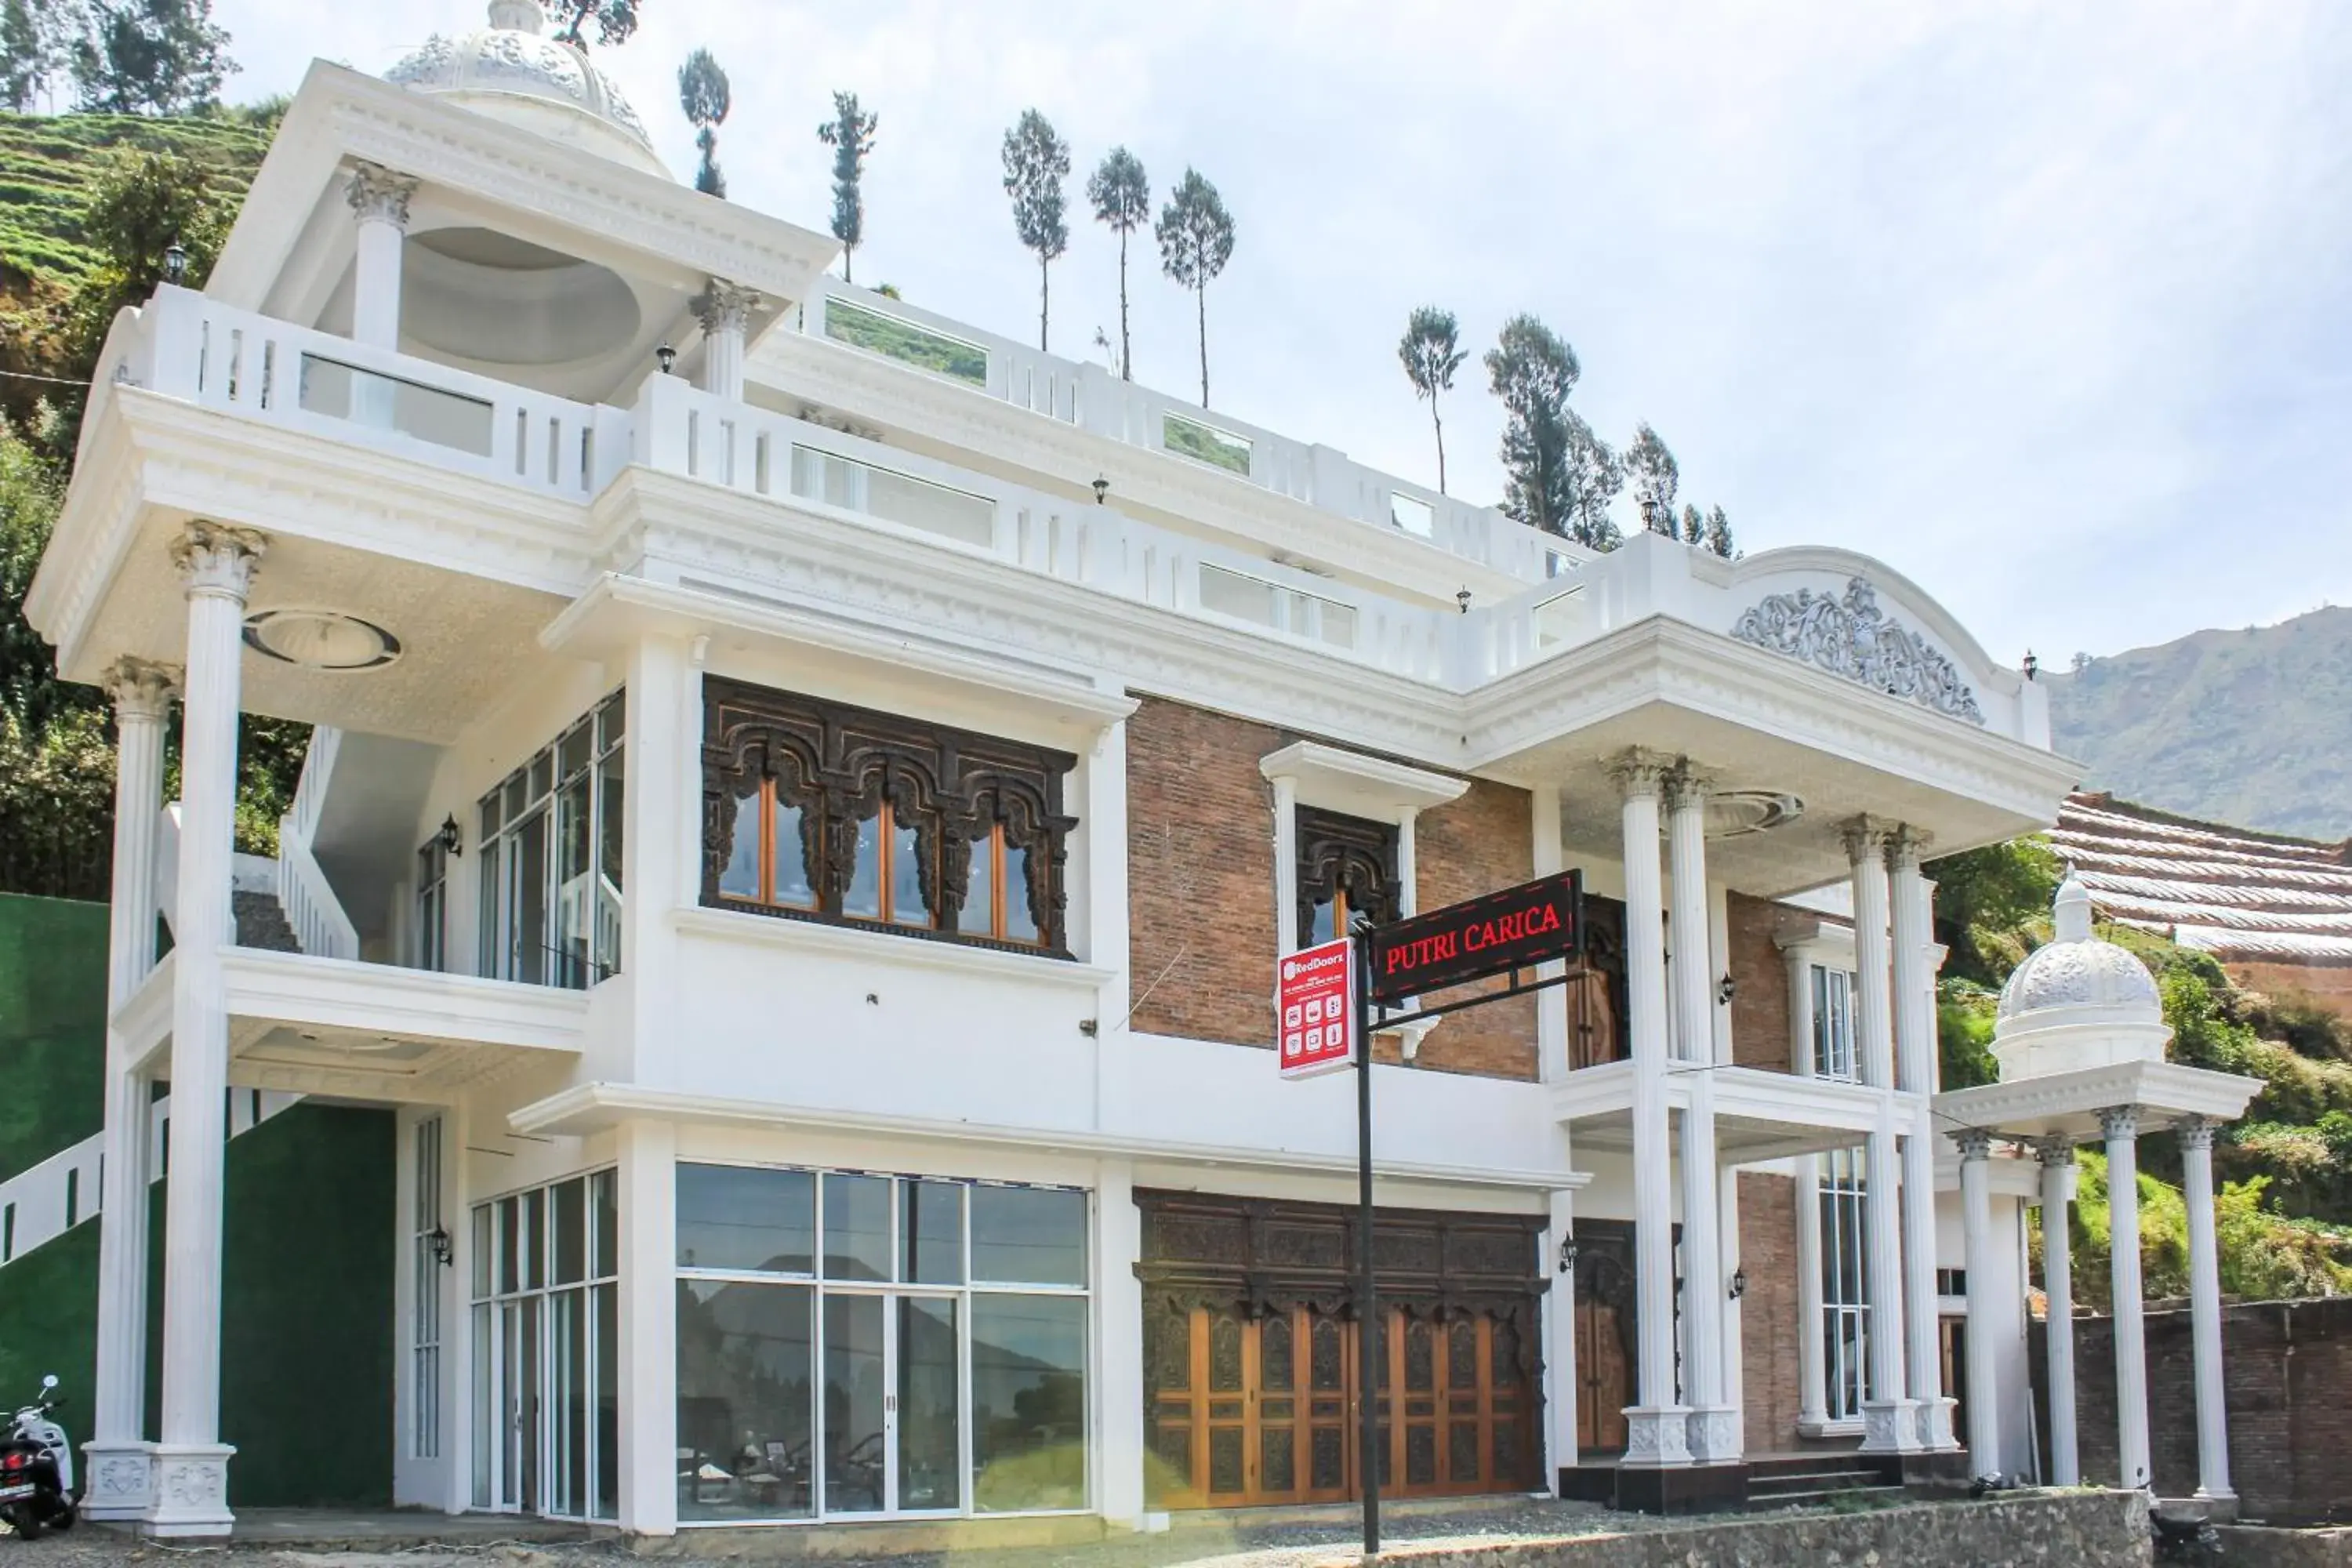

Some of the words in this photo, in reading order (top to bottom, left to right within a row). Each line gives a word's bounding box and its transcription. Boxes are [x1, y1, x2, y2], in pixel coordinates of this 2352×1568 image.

[1386, 931, 1457, 975] PUTRI
[1465, 902, 1560, 952] CARICA
[1296, 954, 1343, 974] RedDoorz
